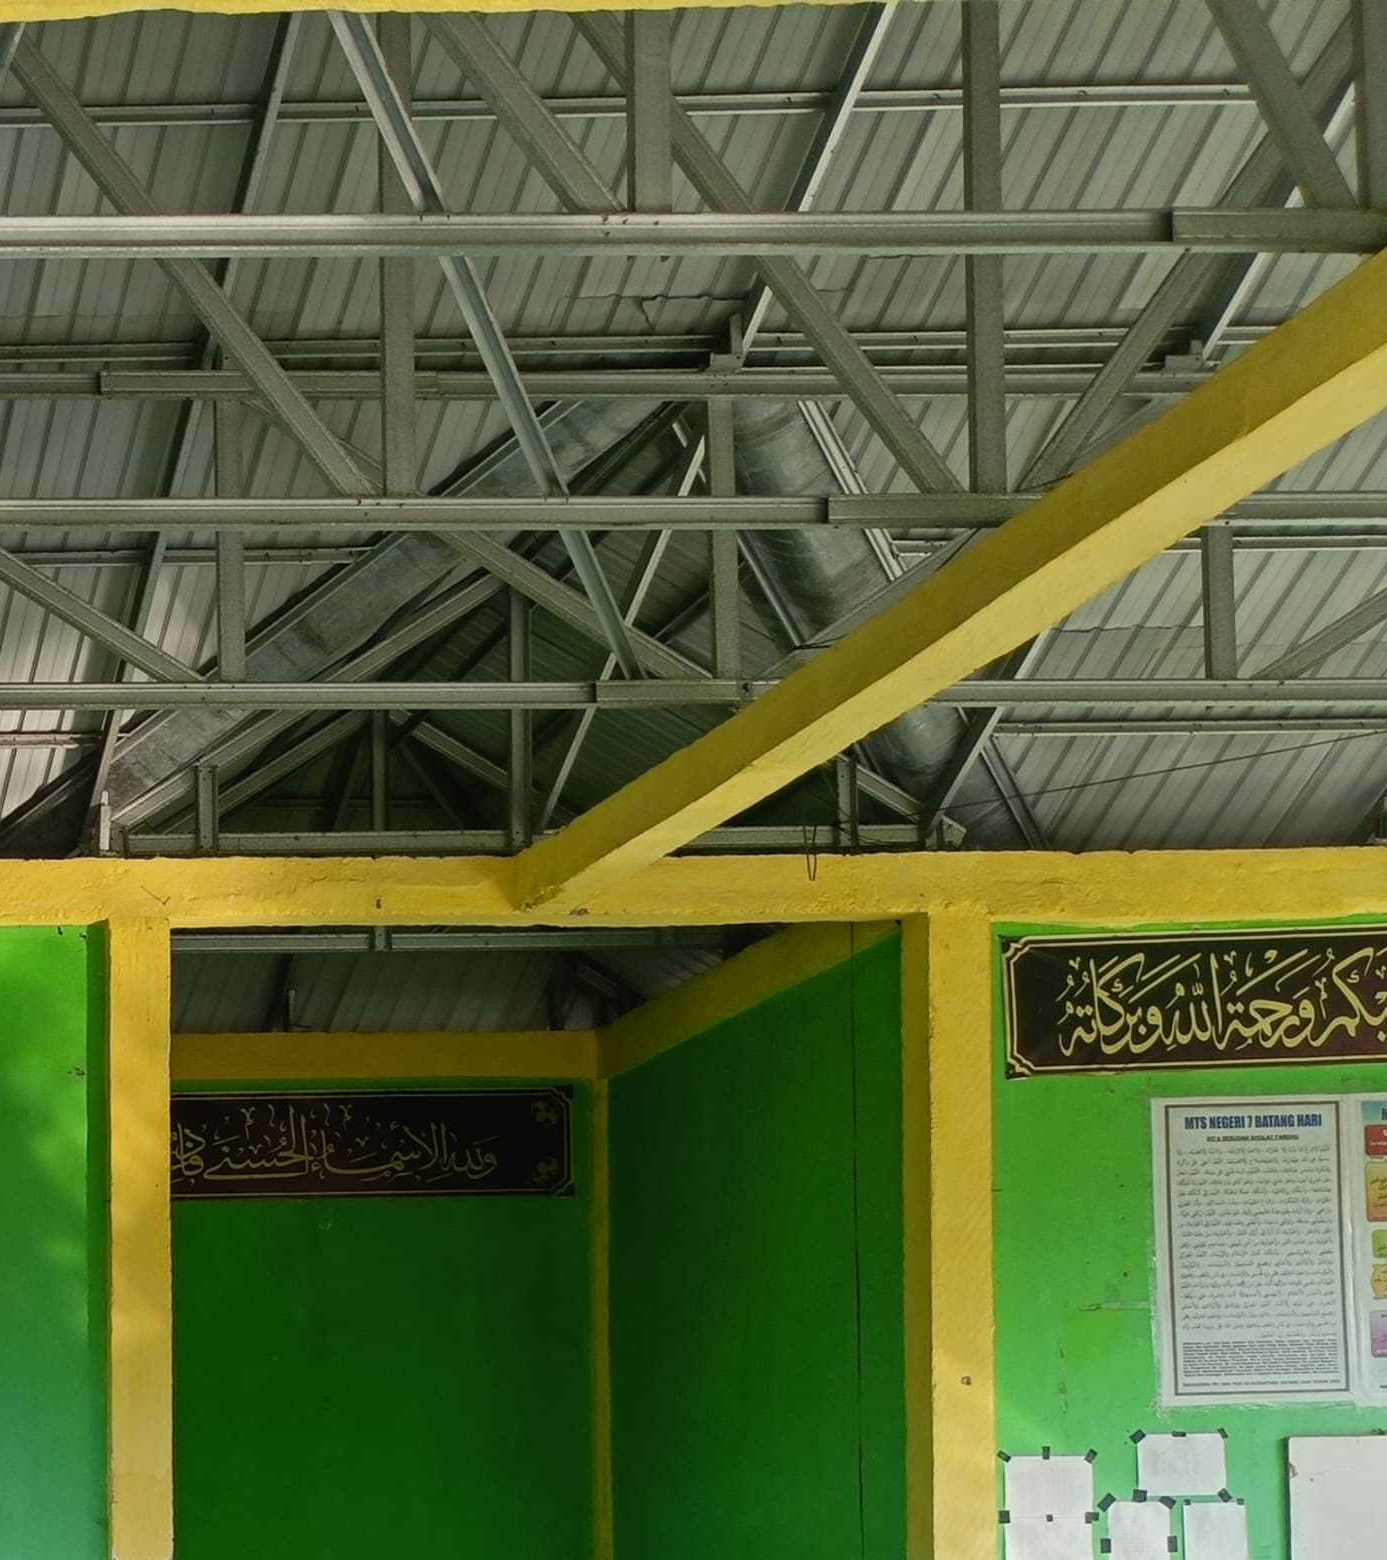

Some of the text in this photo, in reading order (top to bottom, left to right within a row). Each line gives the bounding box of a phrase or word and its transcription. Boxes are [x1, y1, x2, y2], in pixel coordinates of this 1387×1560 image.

[1185, 1113, 1323, 1130] MTS NEGERI 7 BATANG HARI
